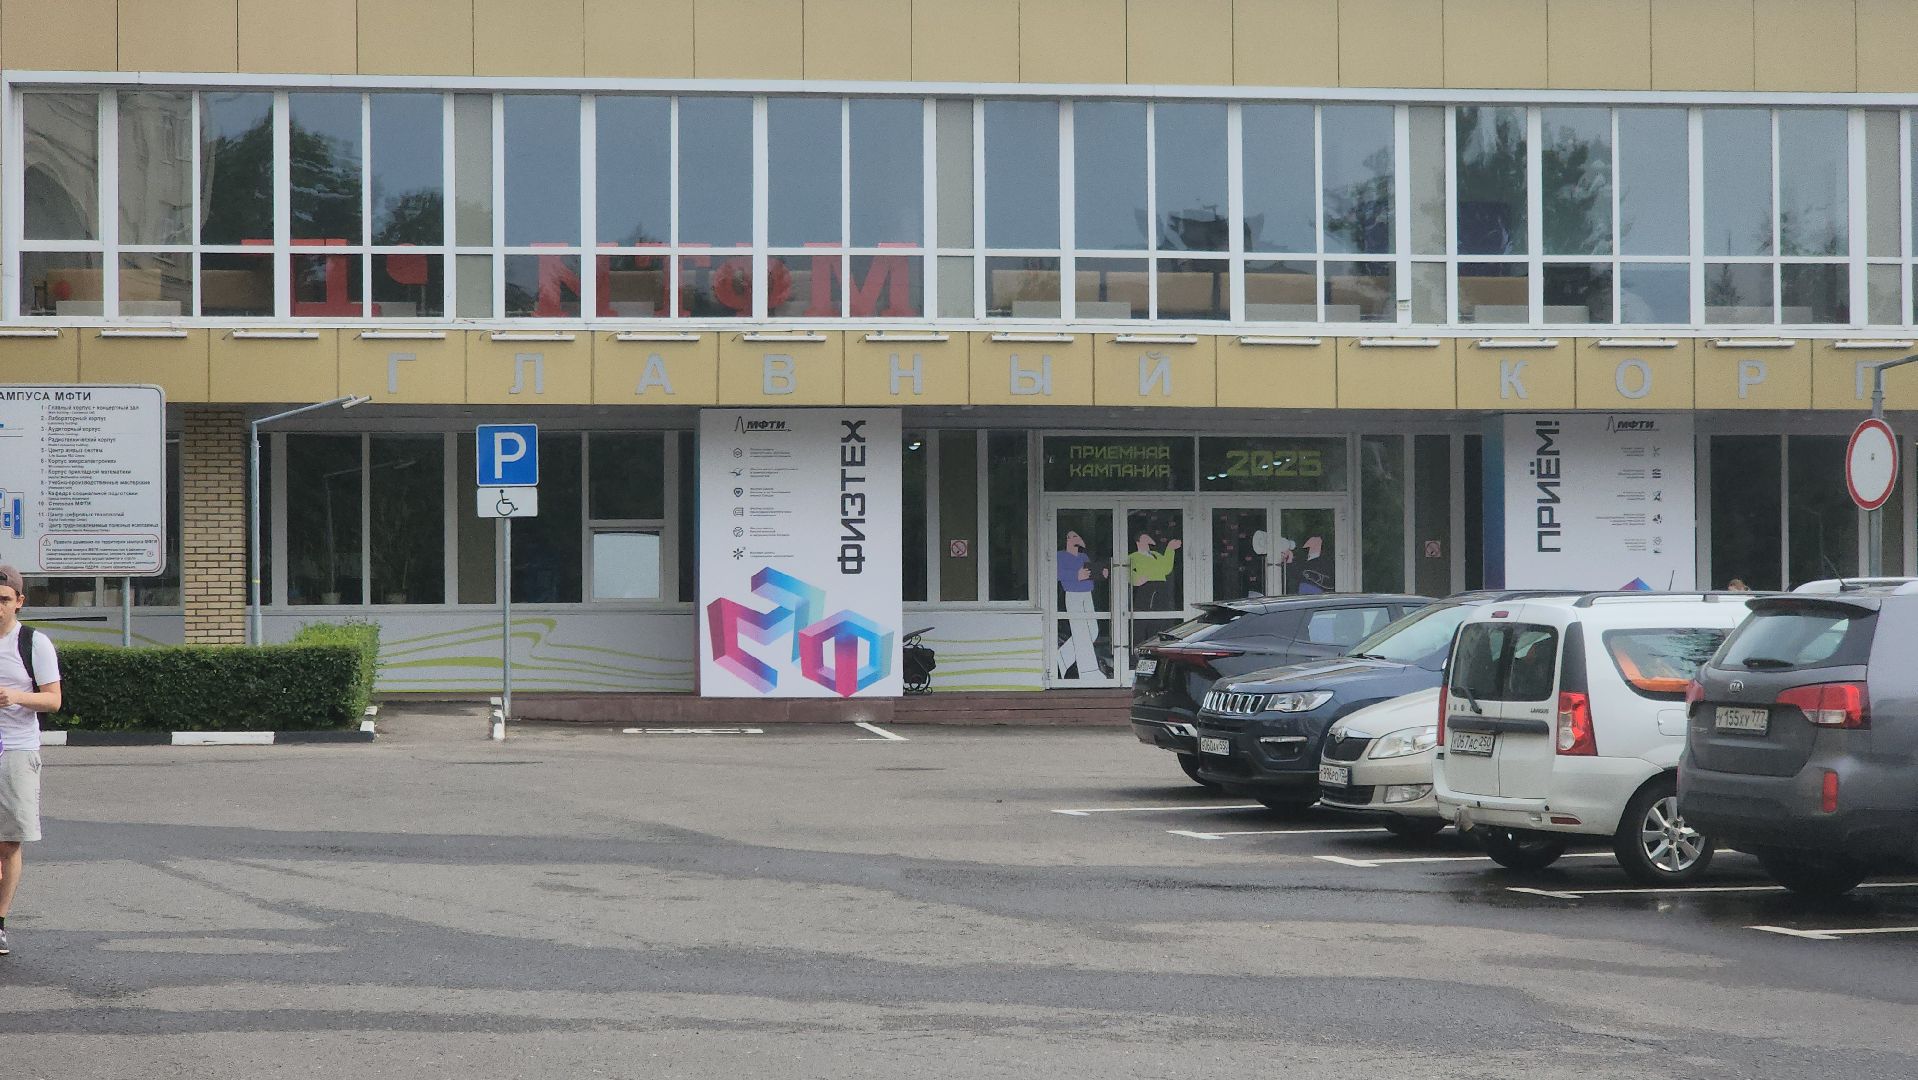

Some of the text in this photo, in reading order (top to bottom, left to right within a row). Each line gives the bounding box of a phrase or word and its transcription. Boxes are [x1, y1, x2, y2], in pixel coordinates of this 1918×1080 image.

[387, 351, 1172, 397] ГЛАВНЫЙ
[55, 391, 91, 401] МФТИ
[747, 419, 786, 429] МФТИ
[1617, 419, 1655, 429] МФТИ
[494, 431, 527, 480] P
[1069, 445, 1170, 460] ПРИЕМНАЯ
[1069, 463, 1171, 478] КАМПАНИЯ
[1226, 450, 1323, 477] 2025
[1530, 420, 1561, 553] ПРИЁМ!
[837, 420, 867, 575] ФИЗТЕХ
